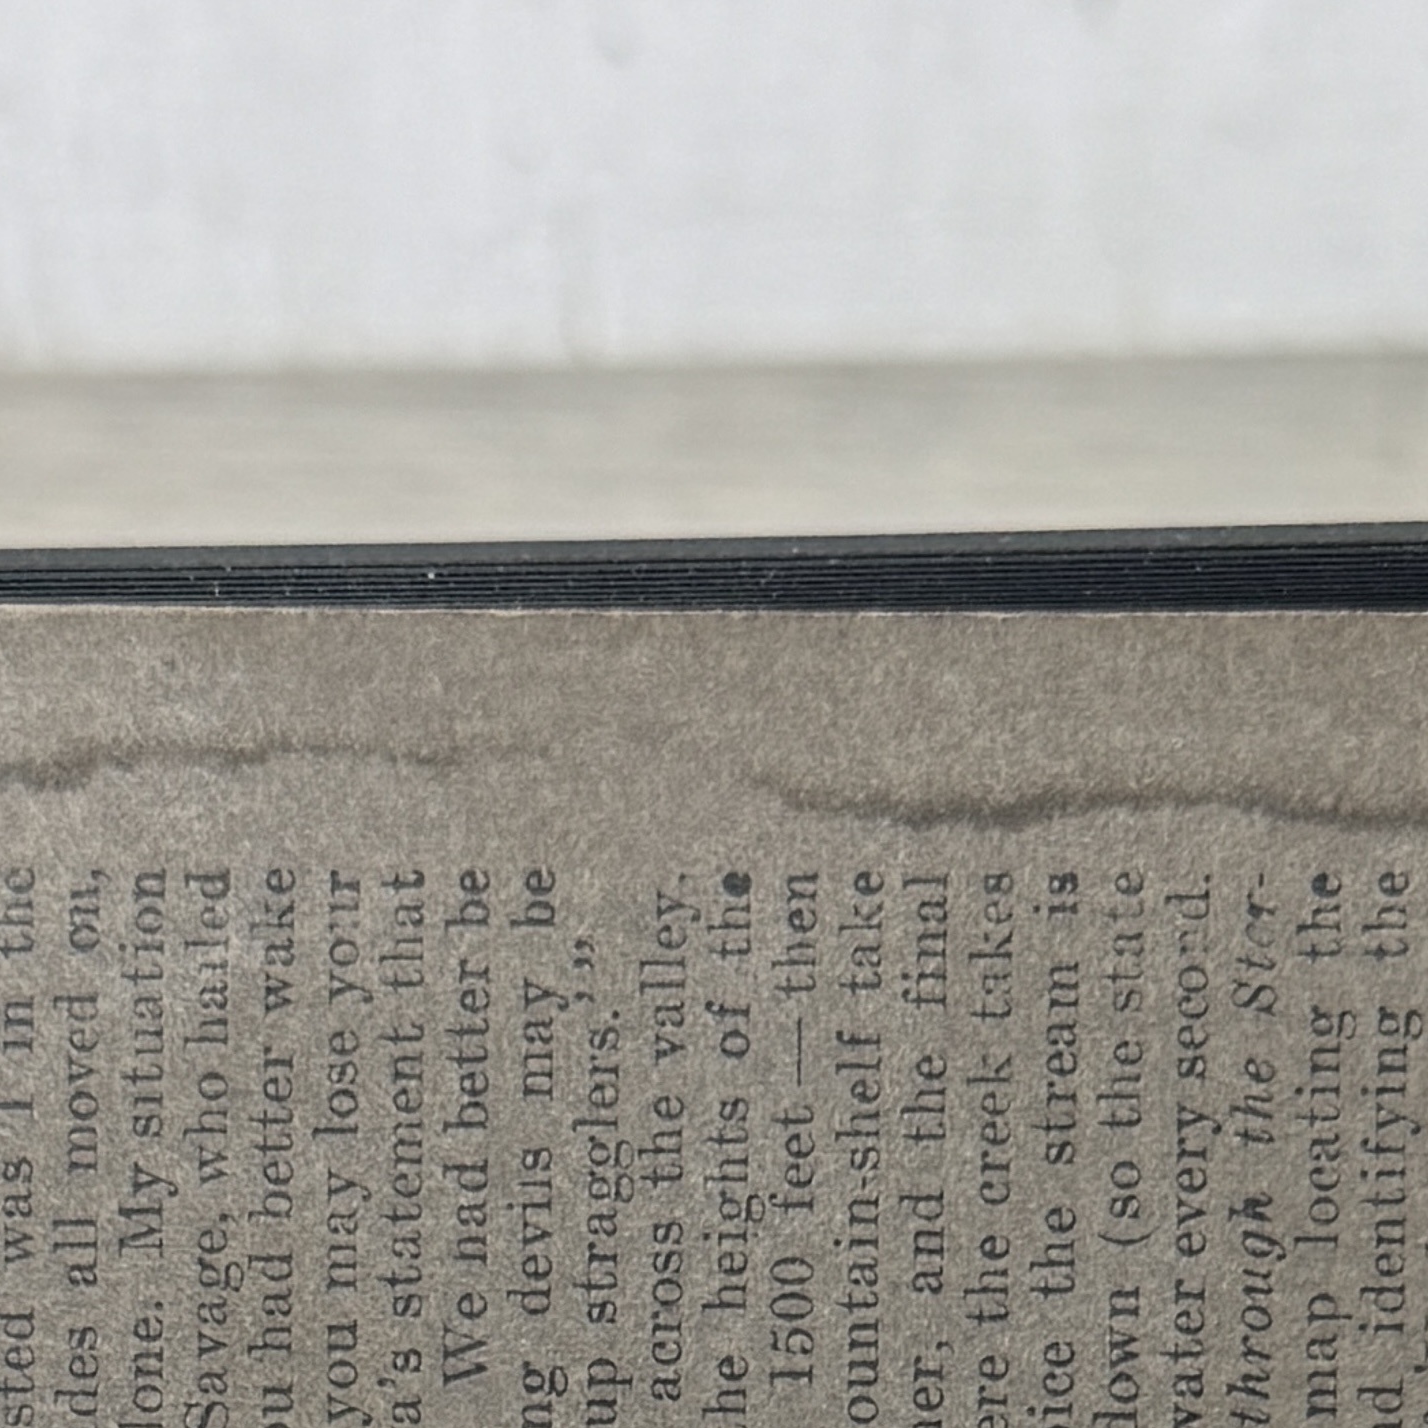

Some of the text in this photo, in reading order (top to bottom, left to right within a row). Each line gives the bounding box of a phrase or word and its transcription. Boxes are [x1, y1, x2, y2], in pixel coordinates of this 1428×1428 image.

[377, 867, 426, 994] that
[508, 867, 557, 929] be
[705, 869, 753, 960] the
[899, 872, 950, 1011] final
[1360, 868, 1411, 963] the
[519, 976, 571, 1101] may
[703, 998, 752, 1061] of
[181, 1069, 230, 1185] who
[635, 1094, 687, 1189] the
[899, 1050, 948, 1145] the
[1227, 1055, 1278, 1149] the
[376, 1021, 427, 1319] statement
[700, 1096, 766, 1315] heights
[1356, 1003, 1425, 1337] identifying
[890, 1187, 946, 1297] and
[649, 1218, 685, 1403] across
[1225, 1191, 1288, 1428] through
